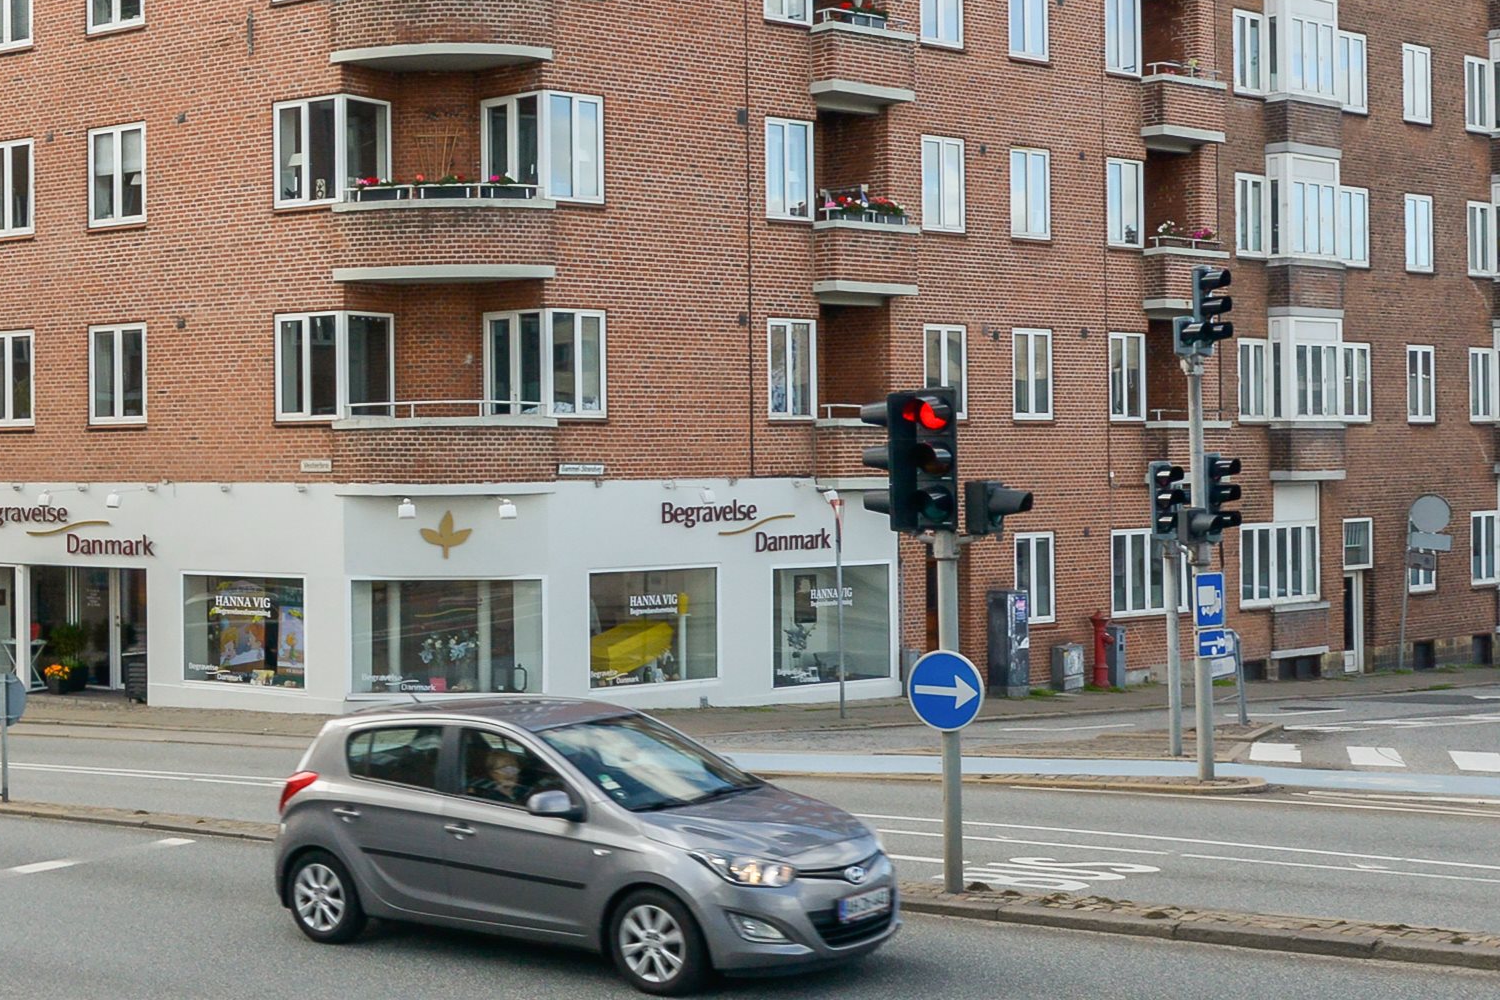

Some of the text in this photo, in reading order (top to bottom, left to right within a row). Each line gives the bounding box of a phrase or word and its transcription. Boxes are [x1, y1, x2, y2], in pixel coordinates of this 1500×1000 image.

[662, 500, 757, 528] Begravelse
[67, 533, 155, 556] Danmark
[756, 528, 831, 552] Danmark
[630, 594, 678, 606] HANNA VIG
[810, 588, 838, 599] HANNA
[215, 595, 271, 608] HANNA VIG
[401, 683, 436, 691] Danmark
